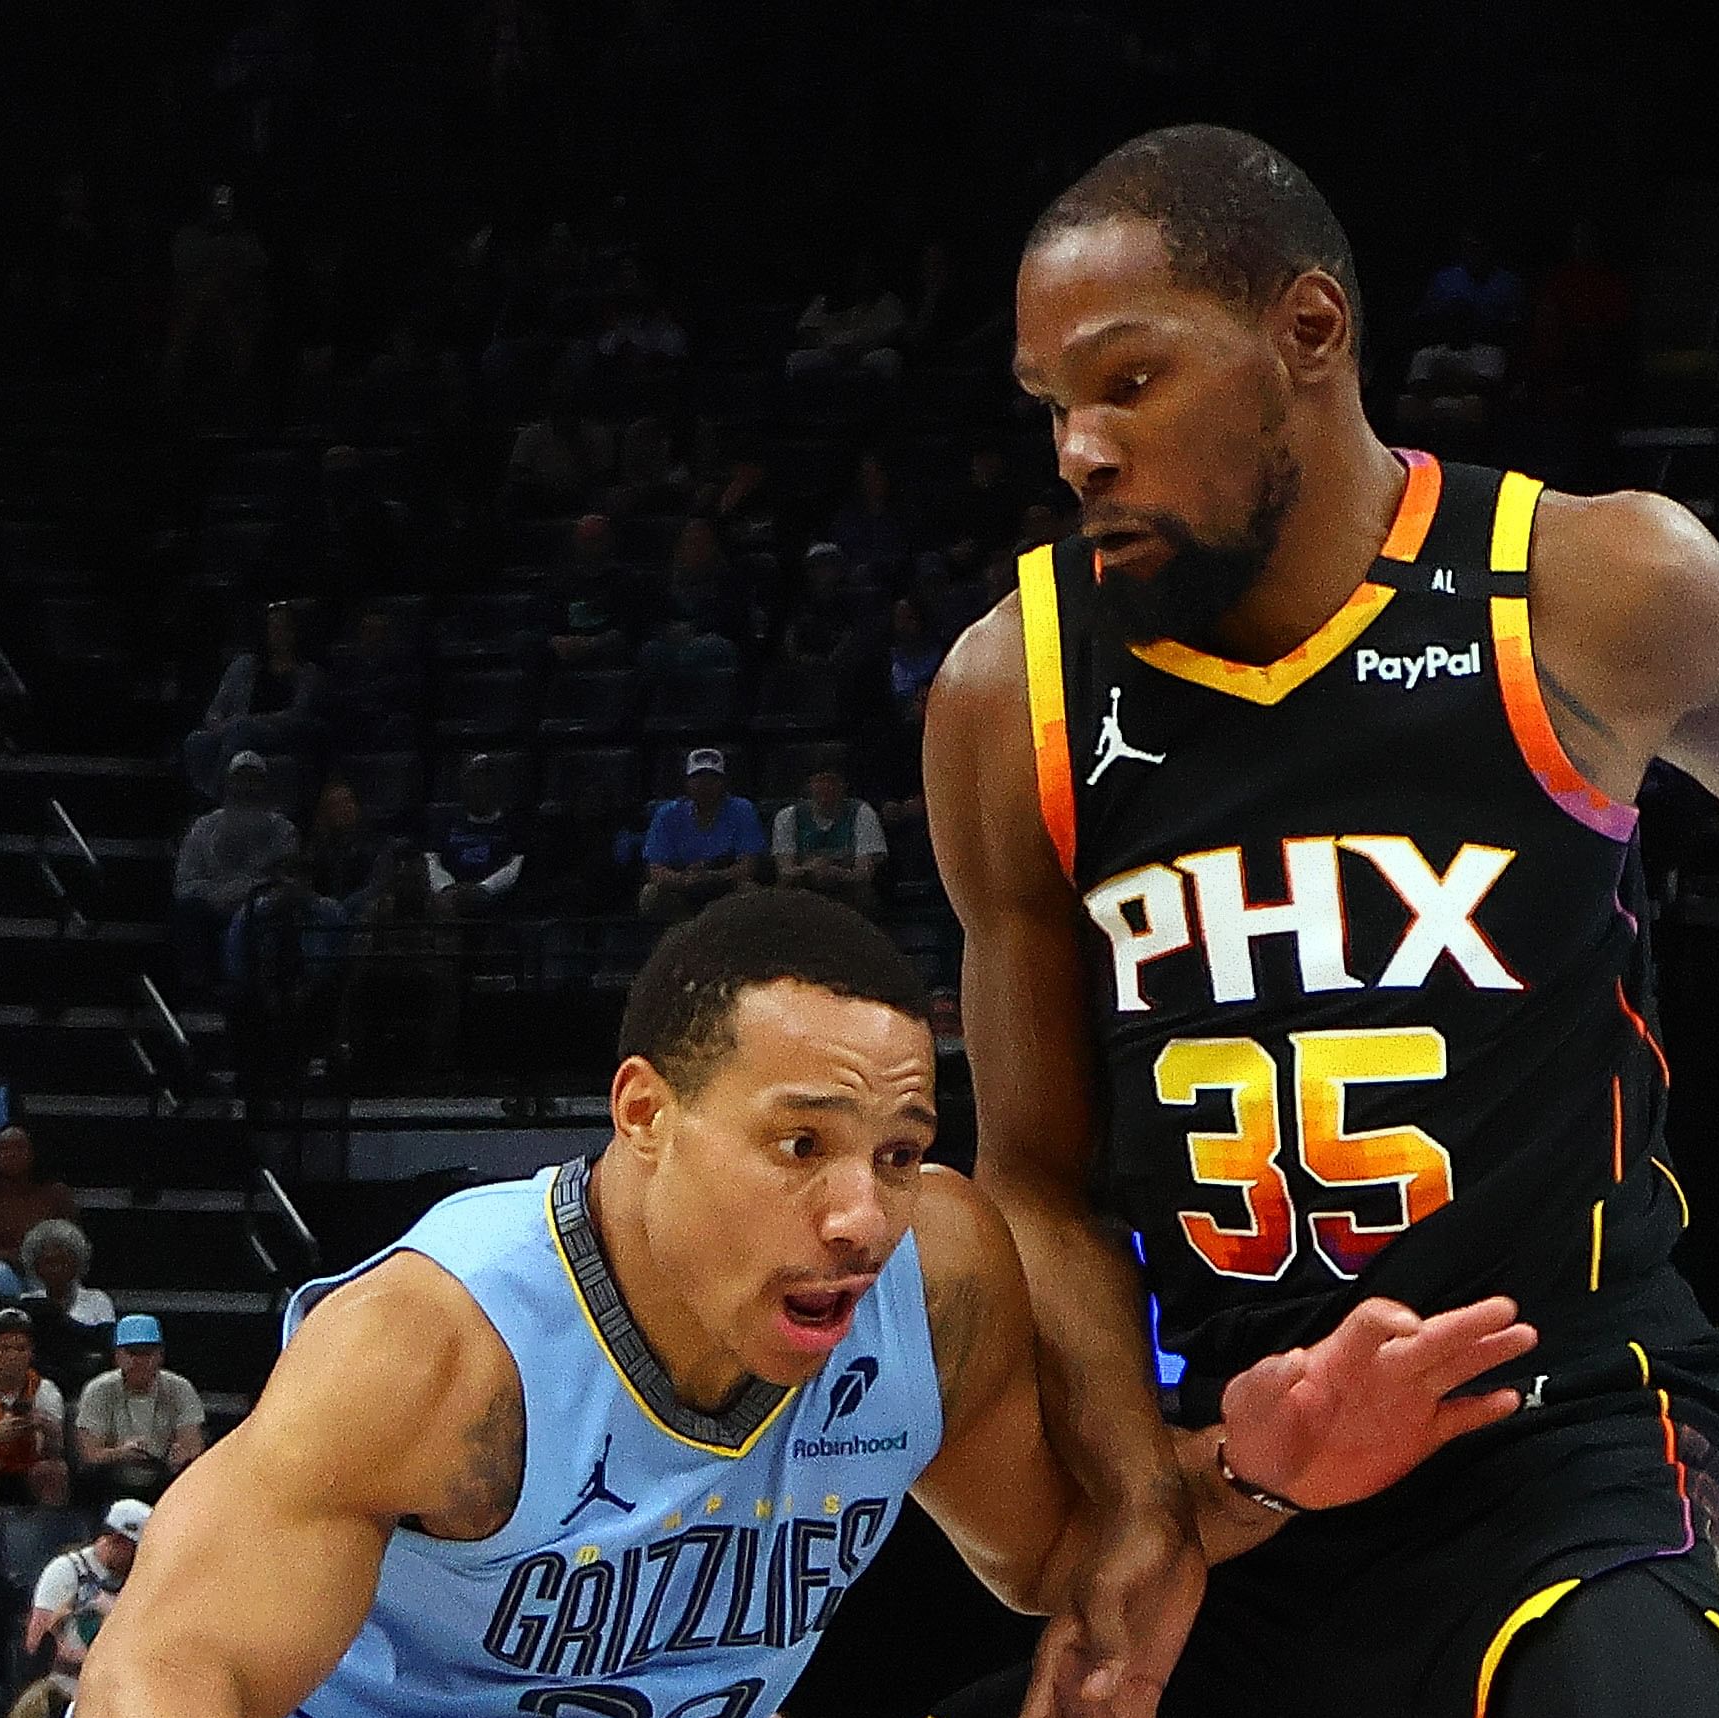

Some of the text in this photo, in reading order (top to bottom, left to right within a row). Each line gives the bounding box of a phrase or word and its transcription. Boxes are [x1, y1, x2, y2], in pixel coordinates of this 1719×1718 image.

[1432, 568, 1456, 594] AL
[1357, 641, 1481, 690] PayPal
[1083, 834, 1531, 1012] PHX
[1154, 1026, 1454, 1282] 35
[793, 1430, 908, 1459] Robinhood
[482, 1498, 889, 1677] GRIZZLIES
